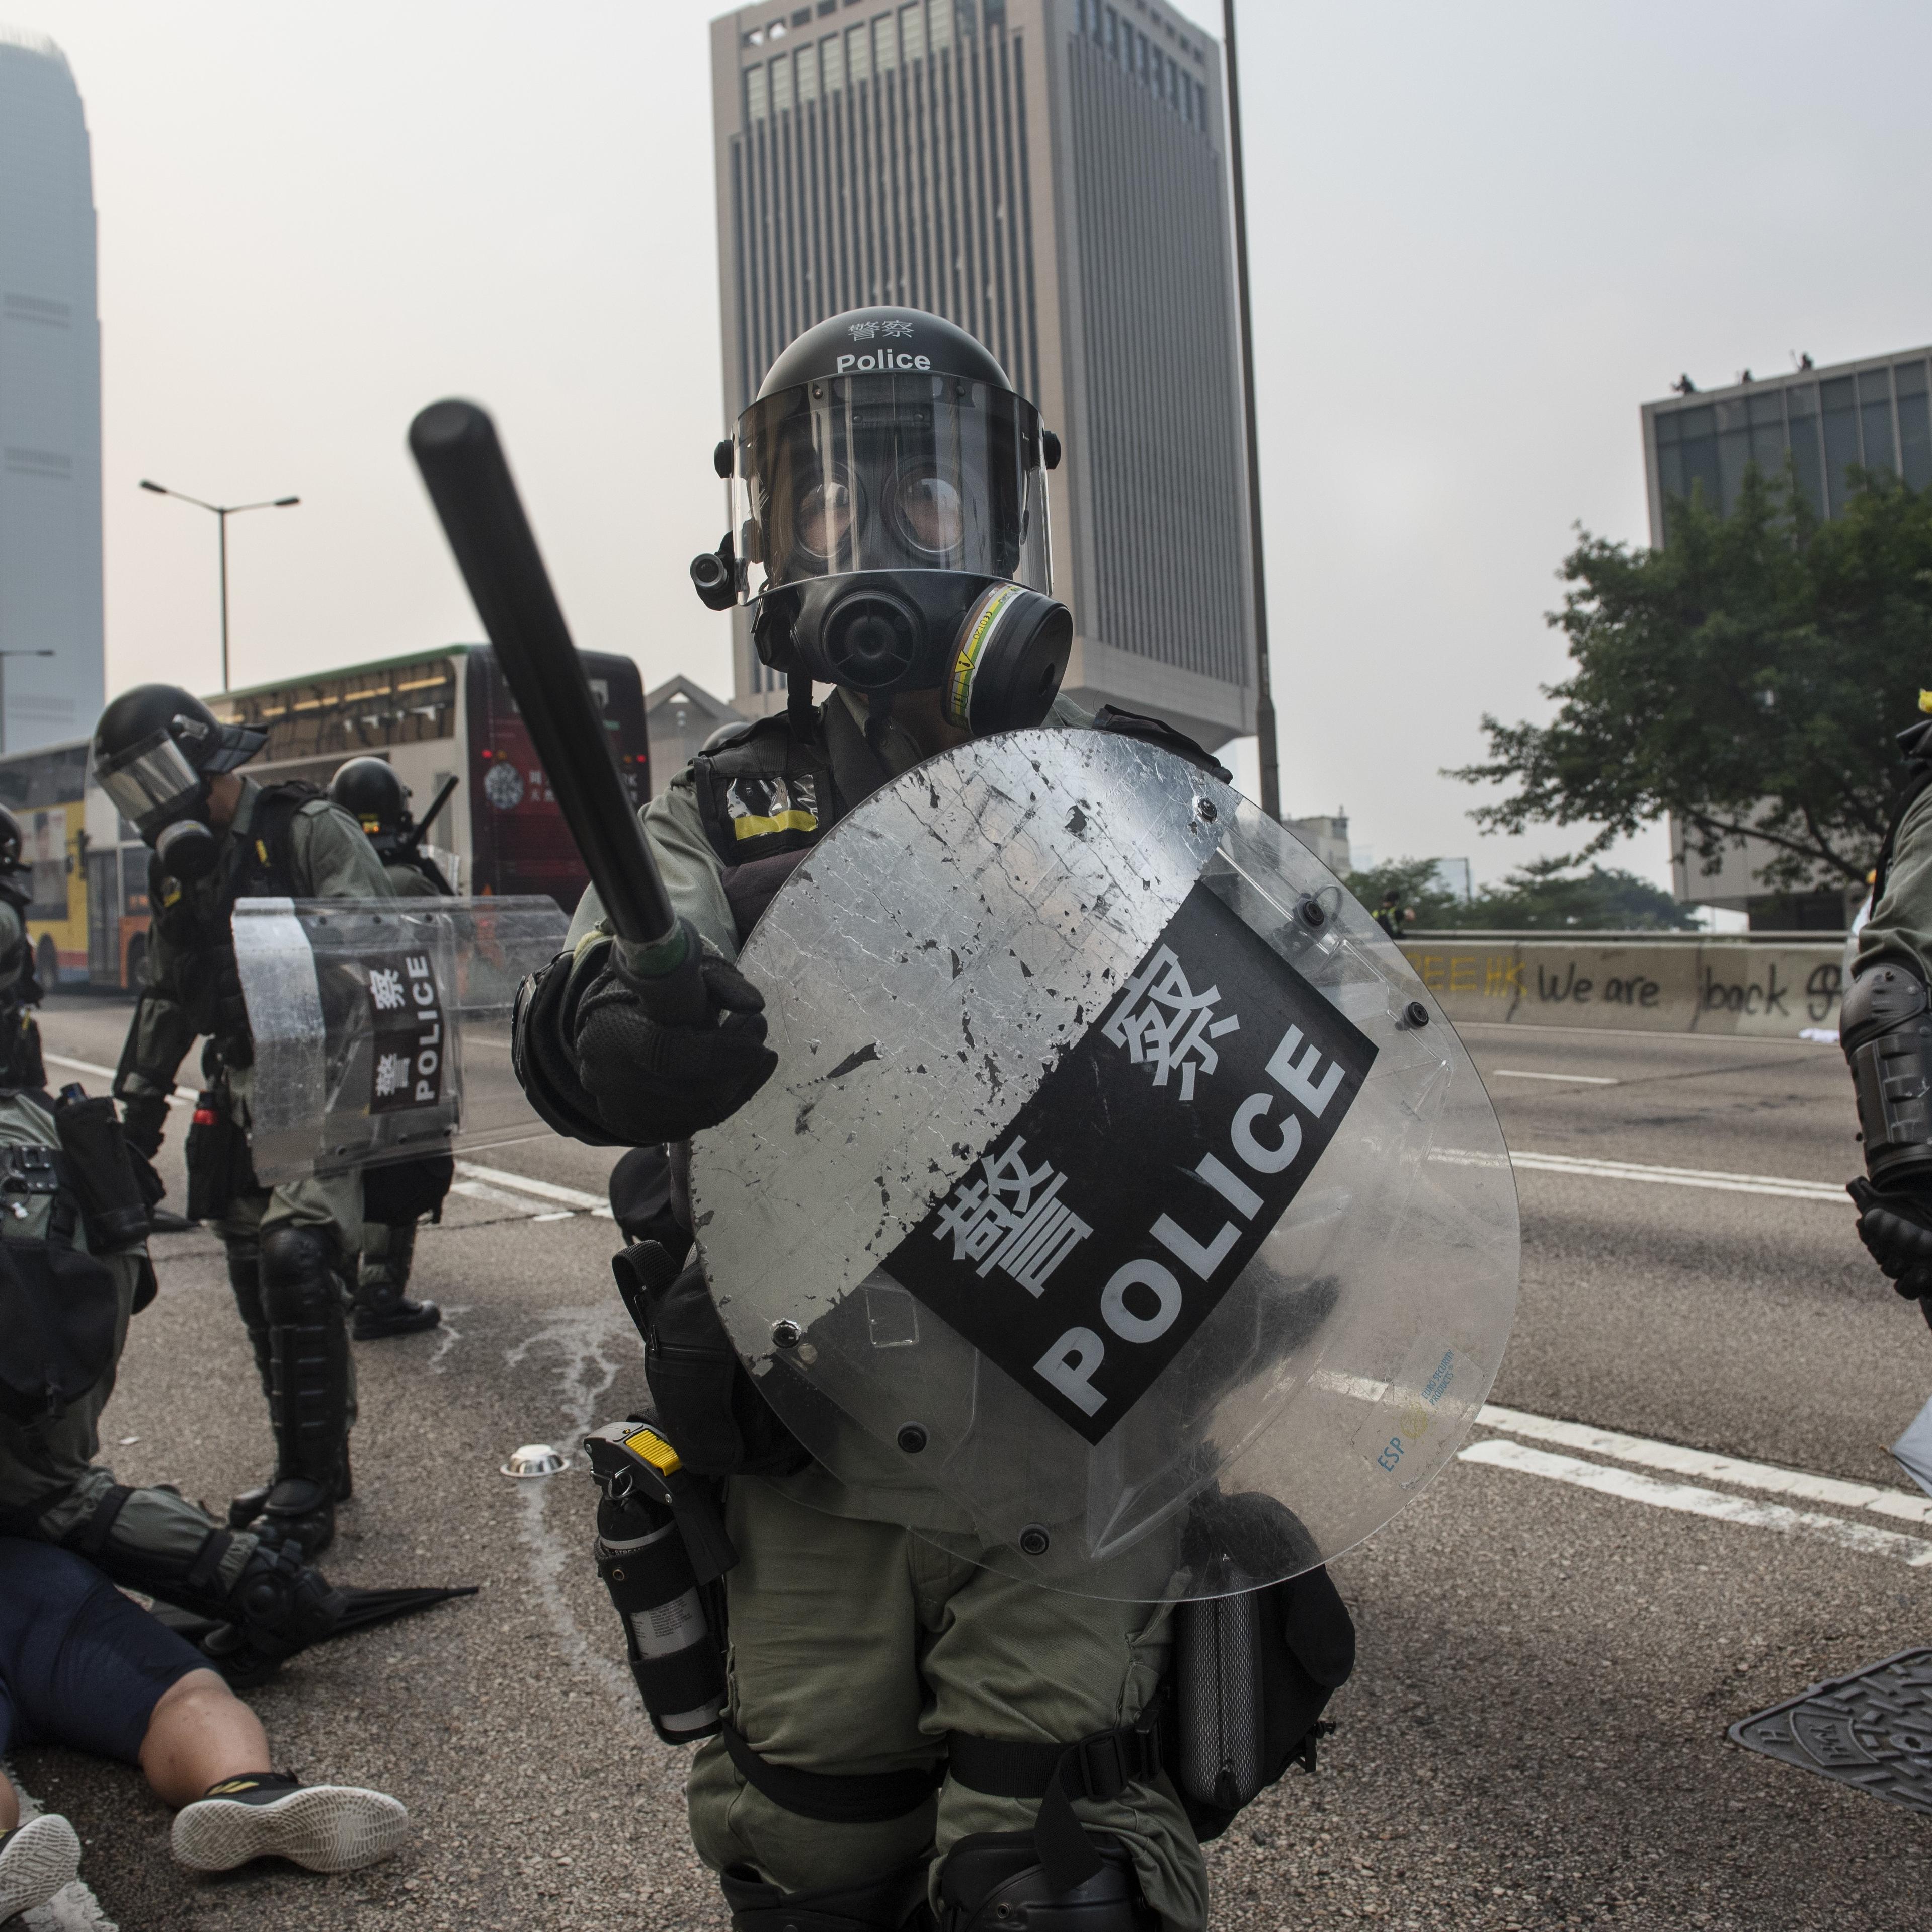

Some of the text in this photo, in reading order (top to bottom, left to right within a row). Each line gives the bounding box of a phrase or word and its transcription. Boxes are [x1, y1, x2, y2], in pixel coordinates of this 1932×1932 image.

[848, 320, 914, 342] 警察
[837, 348, 931, 374] Police
[1538, 962, 1790, 1016] We are back
[369, 968, 411, 1097] 警察
[405, 956, 440, 1102] POLICE
[932, 942, 1240, 1298] 警察
[1032, 1023, 1345, 1417] POLICE
[1421, 1349, 1455, 1400] EURO SECURITY
[1377, 1437, 1404, 1472] ESP
